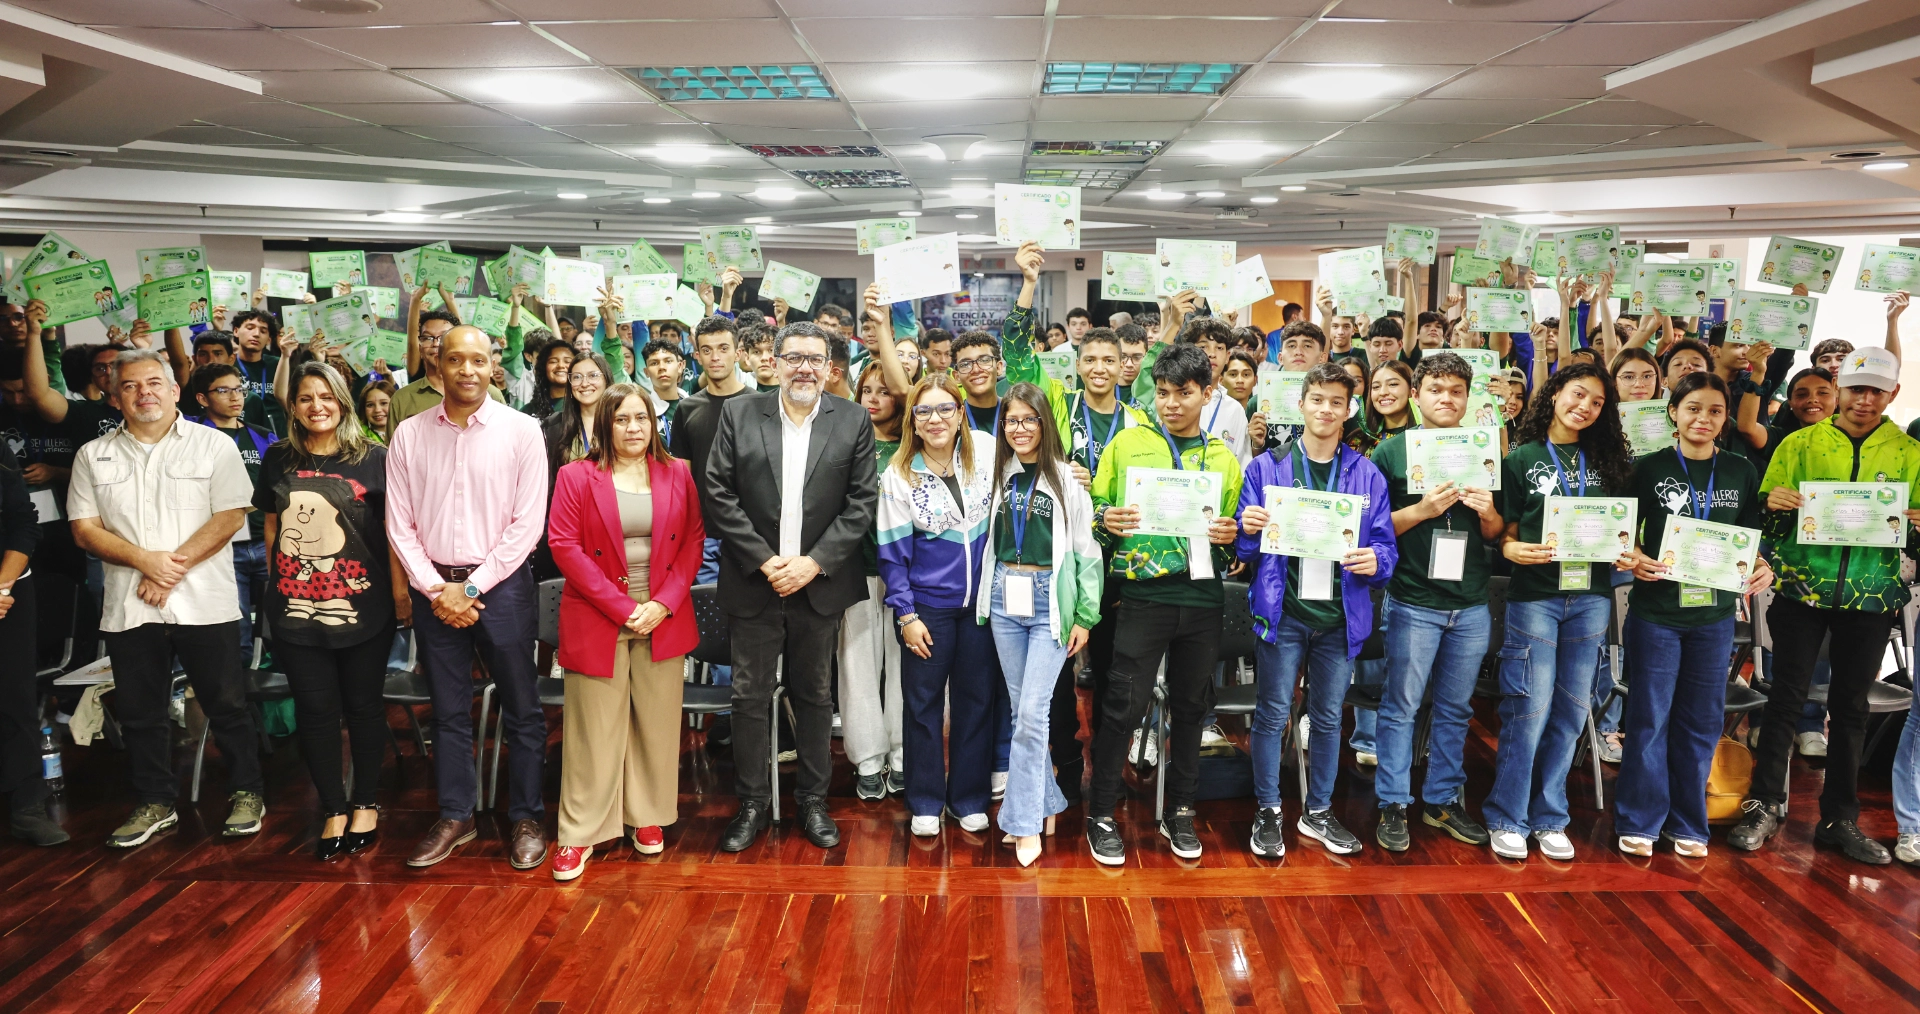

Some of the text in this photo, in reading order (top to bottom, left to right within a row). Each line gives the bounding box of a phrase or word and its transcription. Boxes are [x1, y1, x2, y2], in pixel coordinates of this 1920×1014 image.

[1793, 244, 1821, 252] CERTIFICADO
[159, 281, 185, 290] CERTIFICADO
[326, 300, 348, 309] CERTIFICADO
[1298, 497, 1332, 505] CERTIFICADO
[1696, 527, 1730, 537] CERTIFICADO
